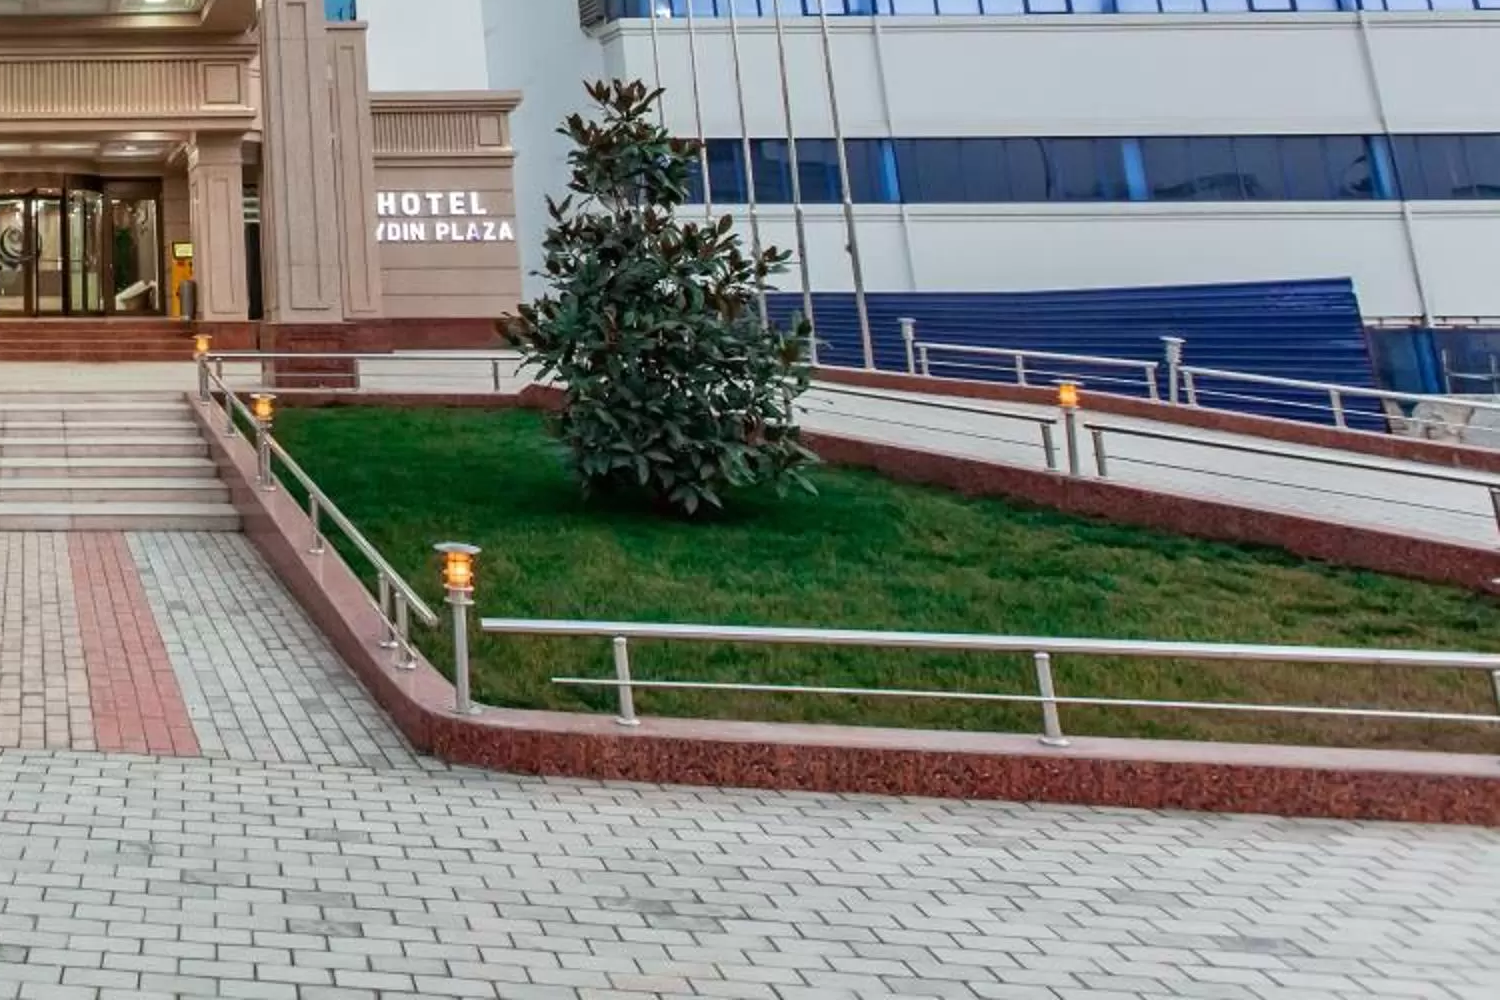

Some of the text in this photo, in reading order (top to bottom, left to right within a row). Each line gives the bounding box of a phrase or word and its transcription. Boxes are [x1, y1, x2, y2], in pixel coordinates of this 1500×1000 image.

[377, 191, 487, 216] HOTEL
[376, 222, 514, 241] YDIN PLAZA
